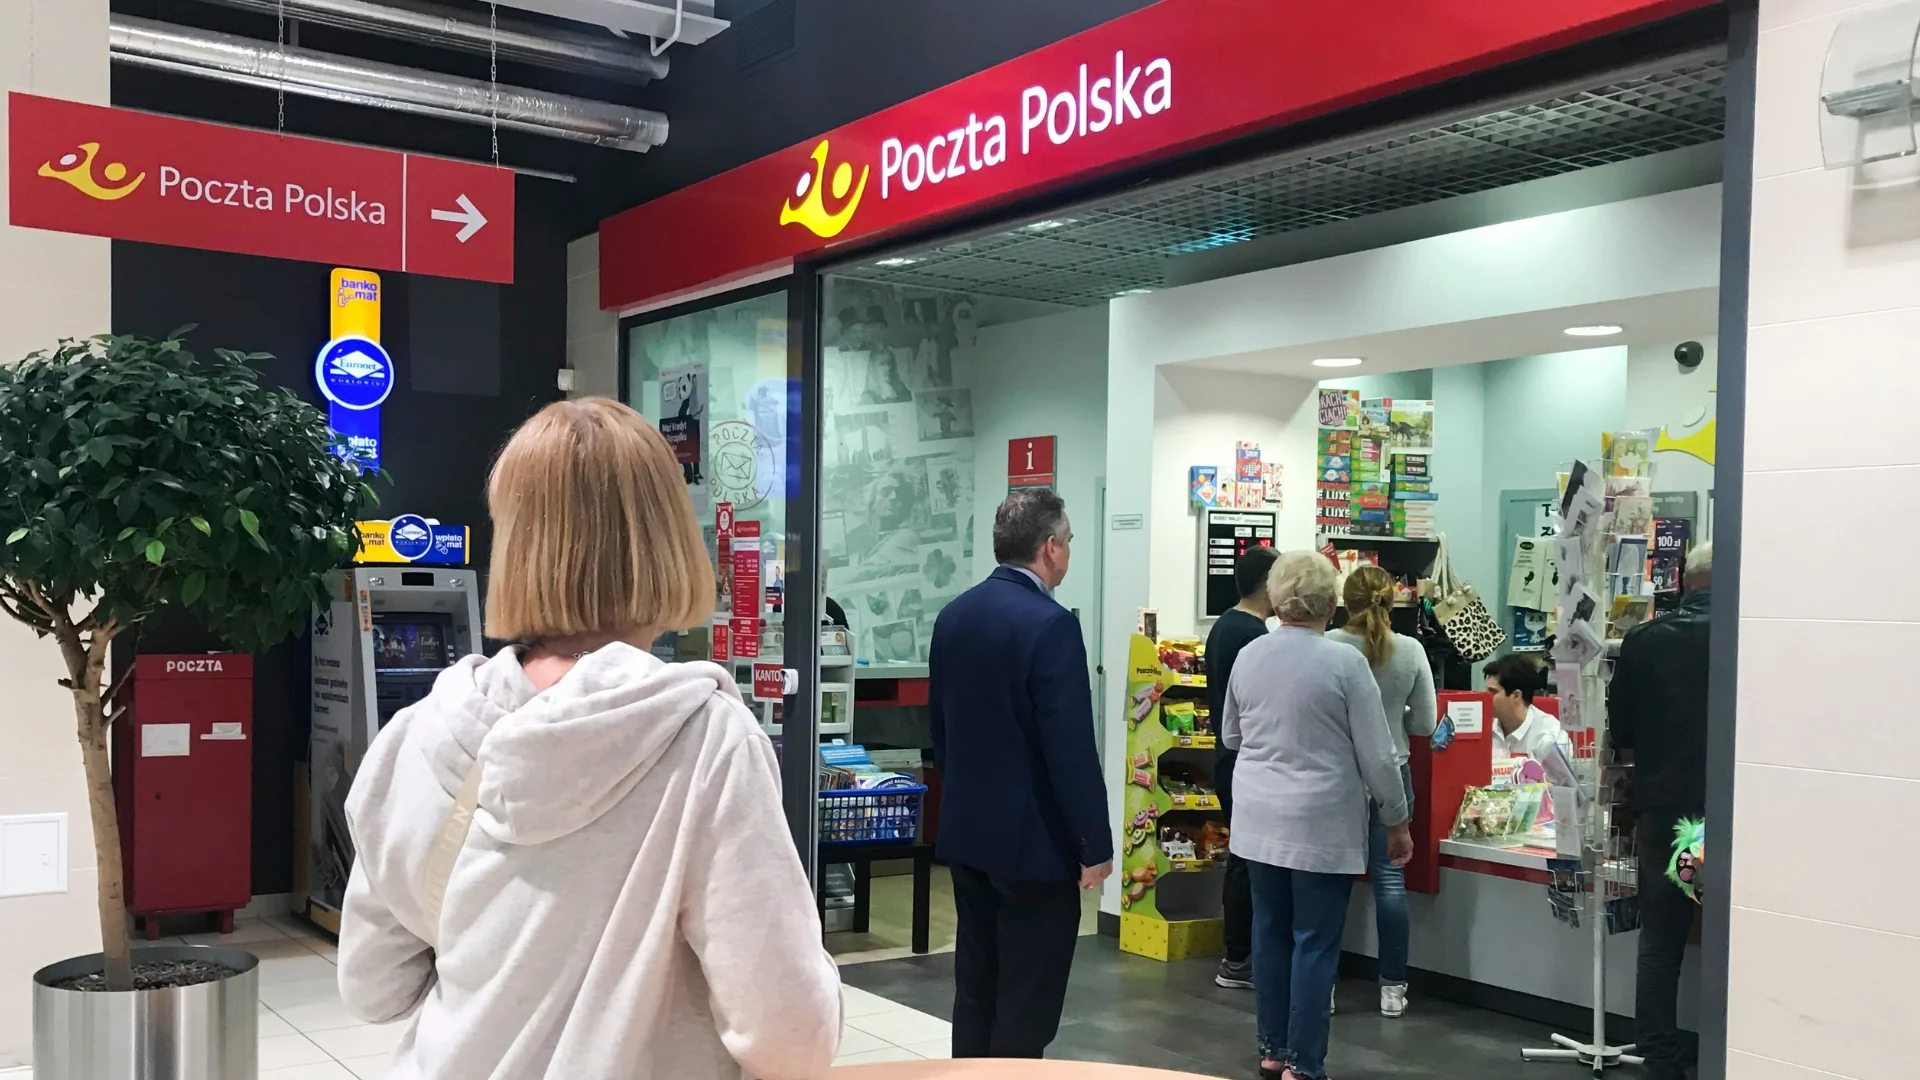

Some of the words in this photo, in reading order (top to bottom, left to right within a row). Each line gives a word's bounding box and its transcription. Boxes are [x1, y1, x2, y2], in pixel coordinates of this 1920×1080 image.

[881, 113, 1007, 199] Poczta
[1021, 49, 1172, 155] Polska
[160, 166, 273, 211] Poczta
[285, 183, 386, 225] Polska
[341, 277, 377, 292] banko
[355, 290, 377, 301] mat
[340, 358, 376, 370] Euronet
[712, 427, 764, 457] POCZTA
[1026, 442, 1034, 470] i
[709, 477, 760, 506] POLSKA
[446, 541, 463, 549] mat
[1657, 535, 1673, 547] 100
[1653, 575, 1663, 586] 50
[166, 660, 223, 672] POCZTA
[755, 669, 785, 683] KANTO
